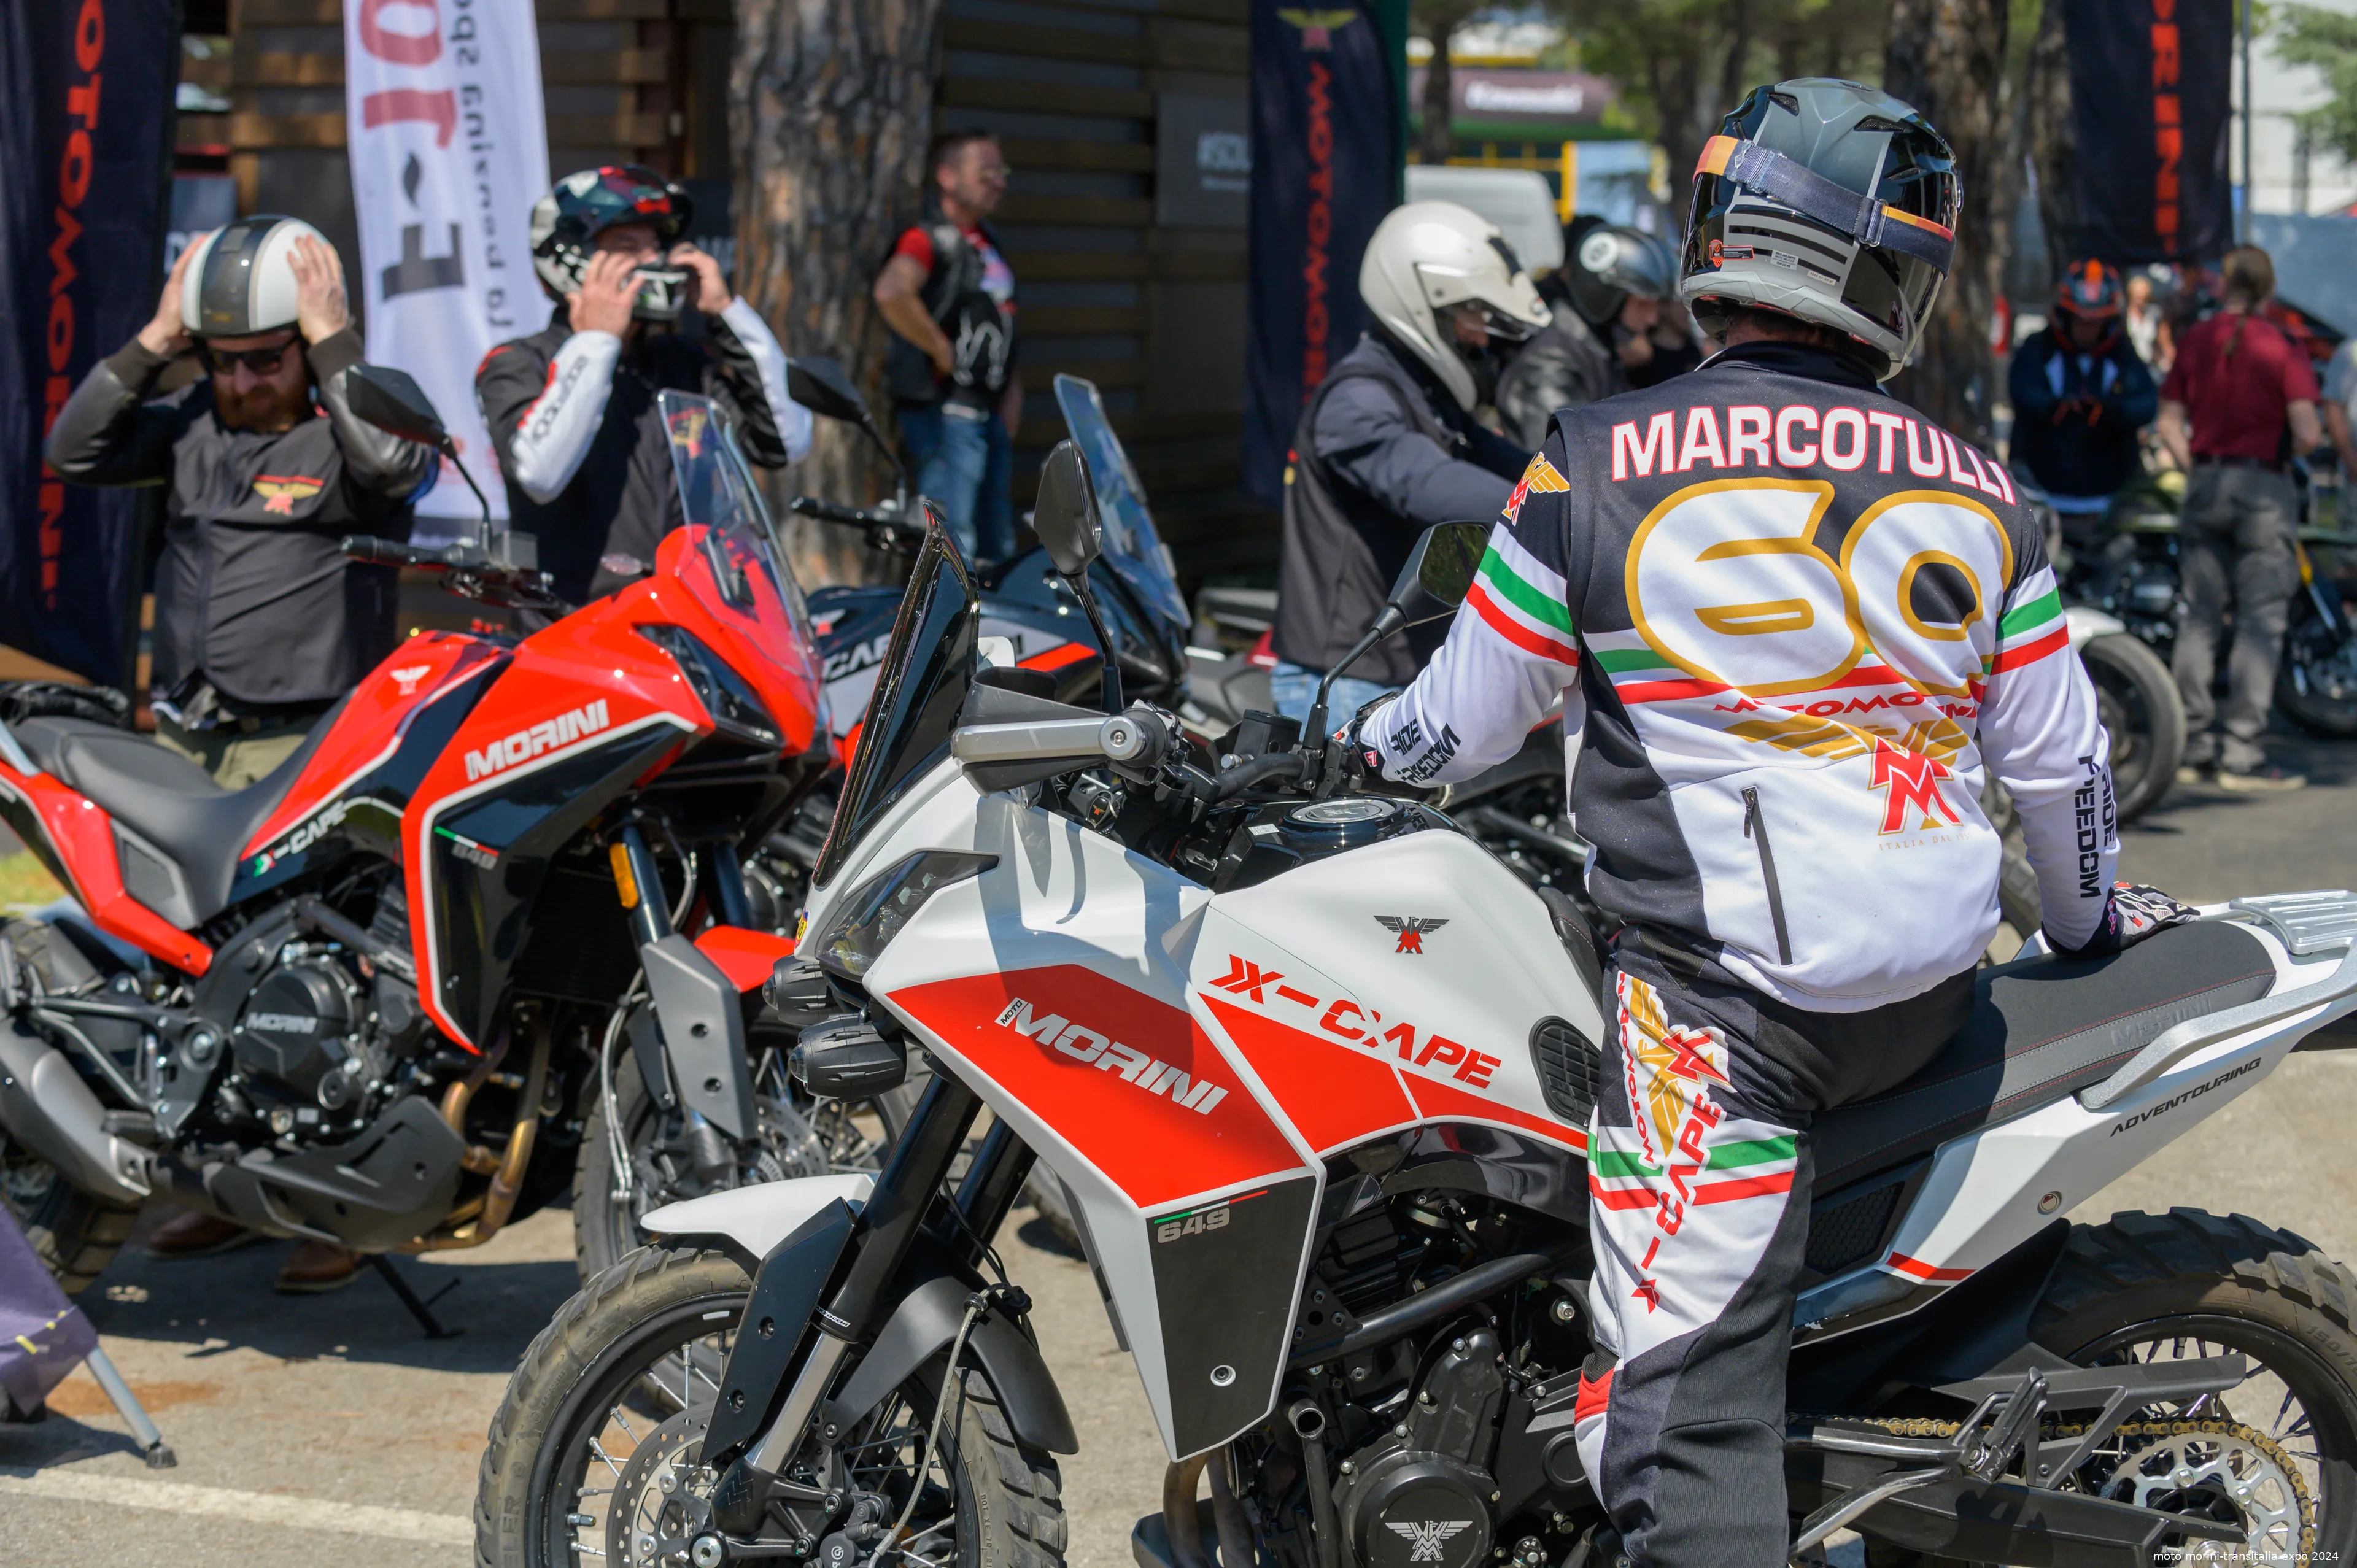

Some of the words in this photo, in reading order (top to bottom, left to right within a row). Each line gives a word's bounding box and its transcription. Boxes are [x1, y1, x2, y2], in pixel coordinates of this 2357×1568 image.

[1612, 405, 2016, 506] MARCOTULLI
[1625, 477, 2013, 700] 60
[464, 698, 610, 782] MORINI
[1879, 839, 1924, 851] ITALIA
[1932, 835, 1952, 844] DAL
[1000, 1000, 1023, 1025] MOTO
[1208, 953, 1501, 1091] X-CAPE
[1015, 1002, 1229, 1116] MORINI
[2110, 1057, 2262, 1138] ADVENTOURING
[1156, 1207, 1231, 1244] 649
[980, 1494, 989, 1511] DOT
[984, 1518, 991, 1530] XE
